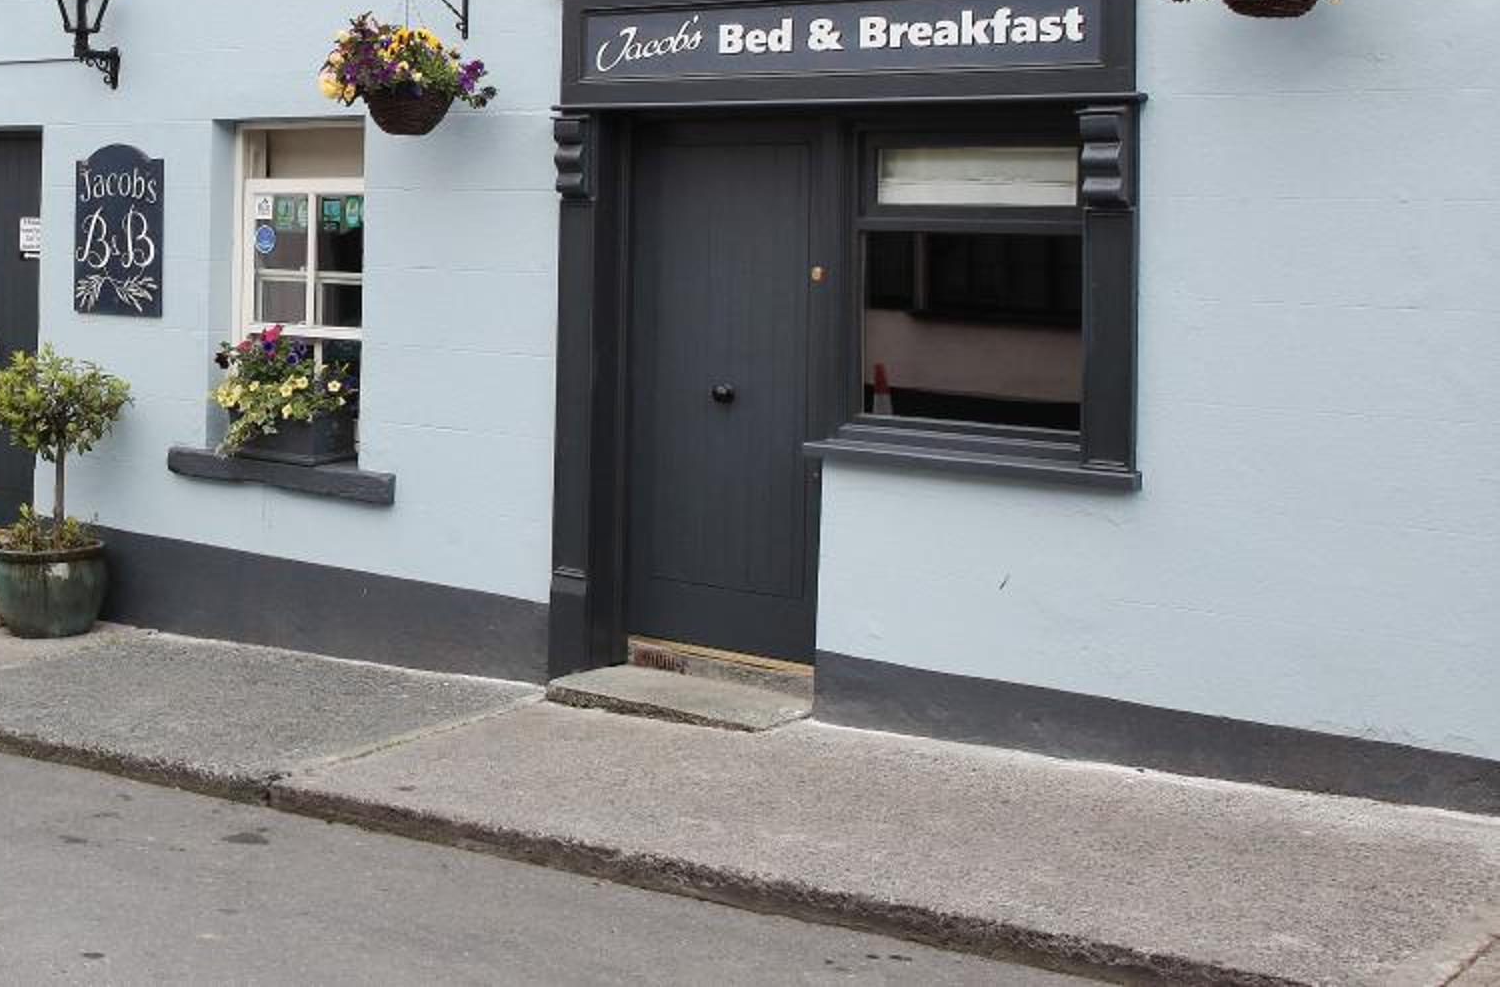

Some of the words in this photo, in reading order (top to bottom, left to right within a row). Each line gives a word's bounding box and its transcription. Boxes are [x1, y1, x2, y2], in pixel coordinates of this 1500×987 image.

[595, 14, 704, 72] Jacob's
[718, 17, 793, 54] Bed
[806, 18, 843, 51] &
[859, 6, 1085, 50] Breakfast
